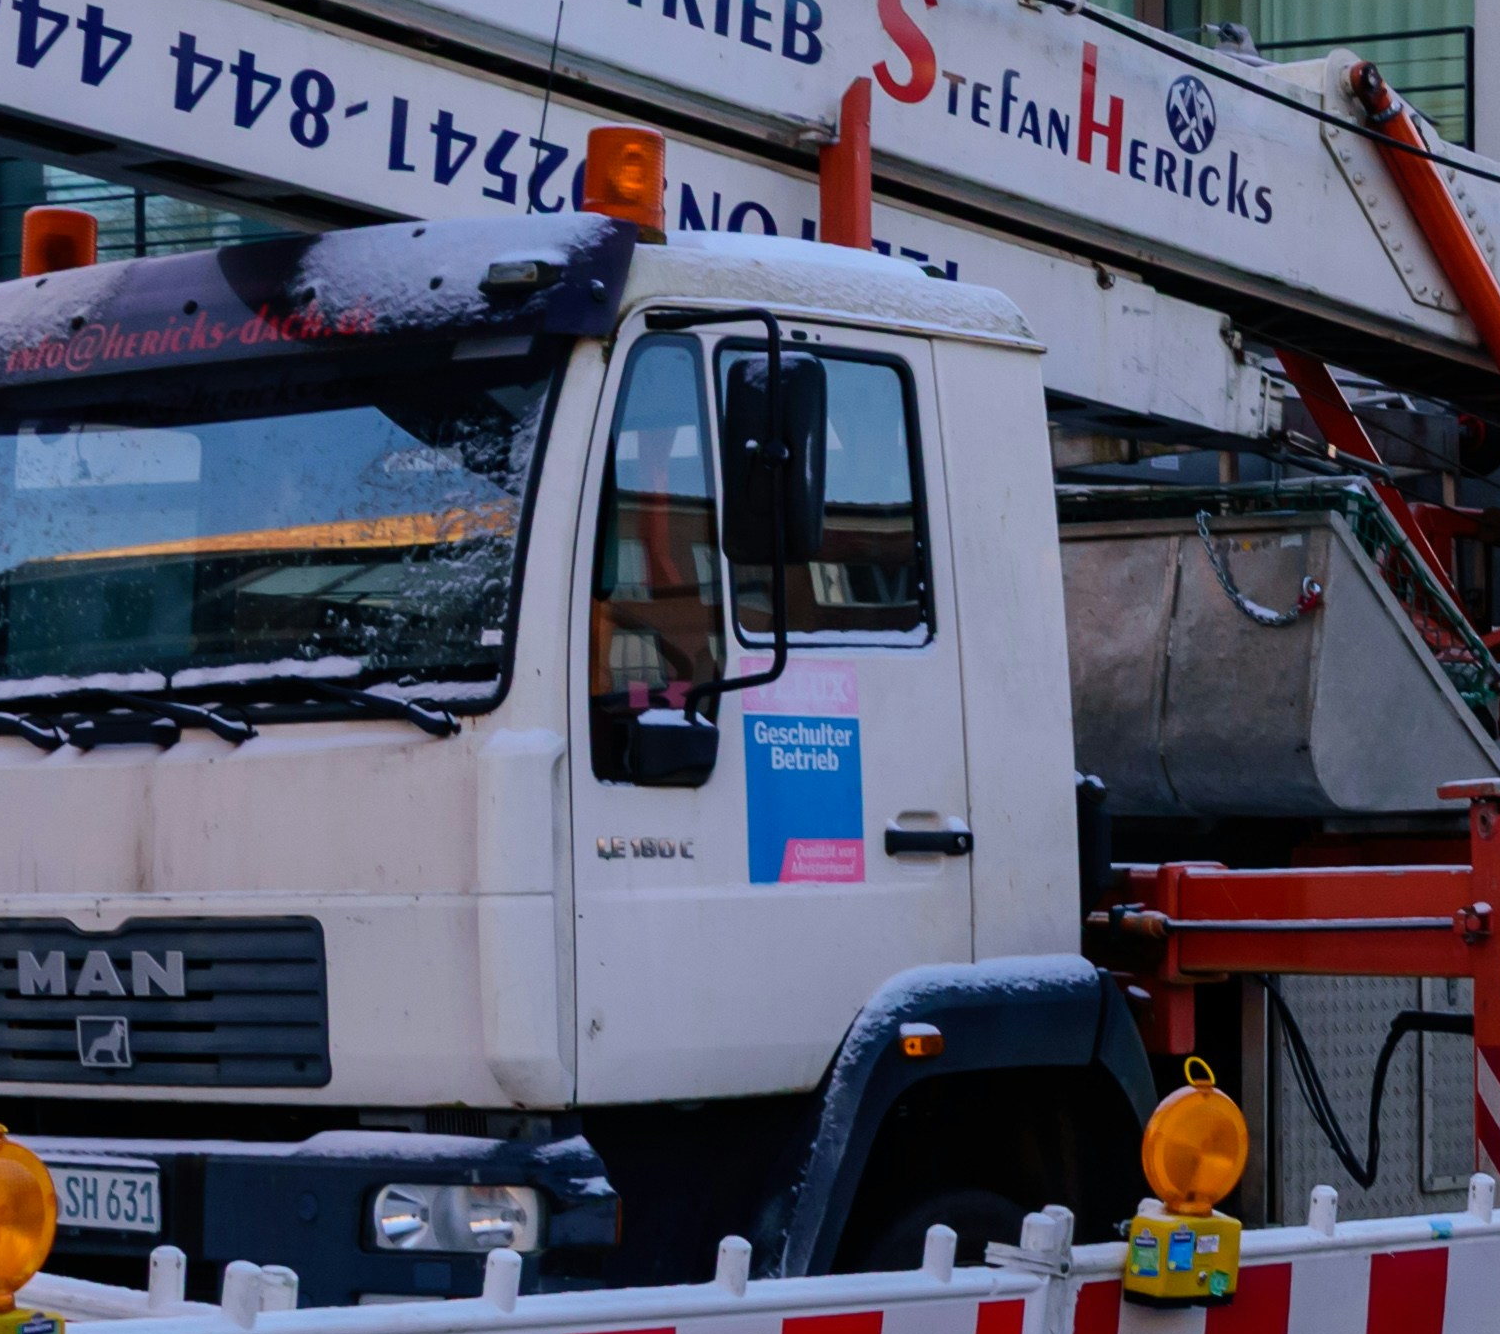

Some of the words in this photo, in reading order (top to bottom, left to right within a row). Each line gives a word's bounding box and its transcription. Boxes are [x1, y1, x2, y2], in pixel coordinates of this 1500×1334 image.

[169, 30, 584, 216] 2541-844
[753, 720, 853, 748] Geschulter
[771, 746, 840, 772] Betrieb
[17, 950, 186, 998] MAN
[65, 1175, 99, 1220] SH
[106, 1178, 155, 1224] 631
